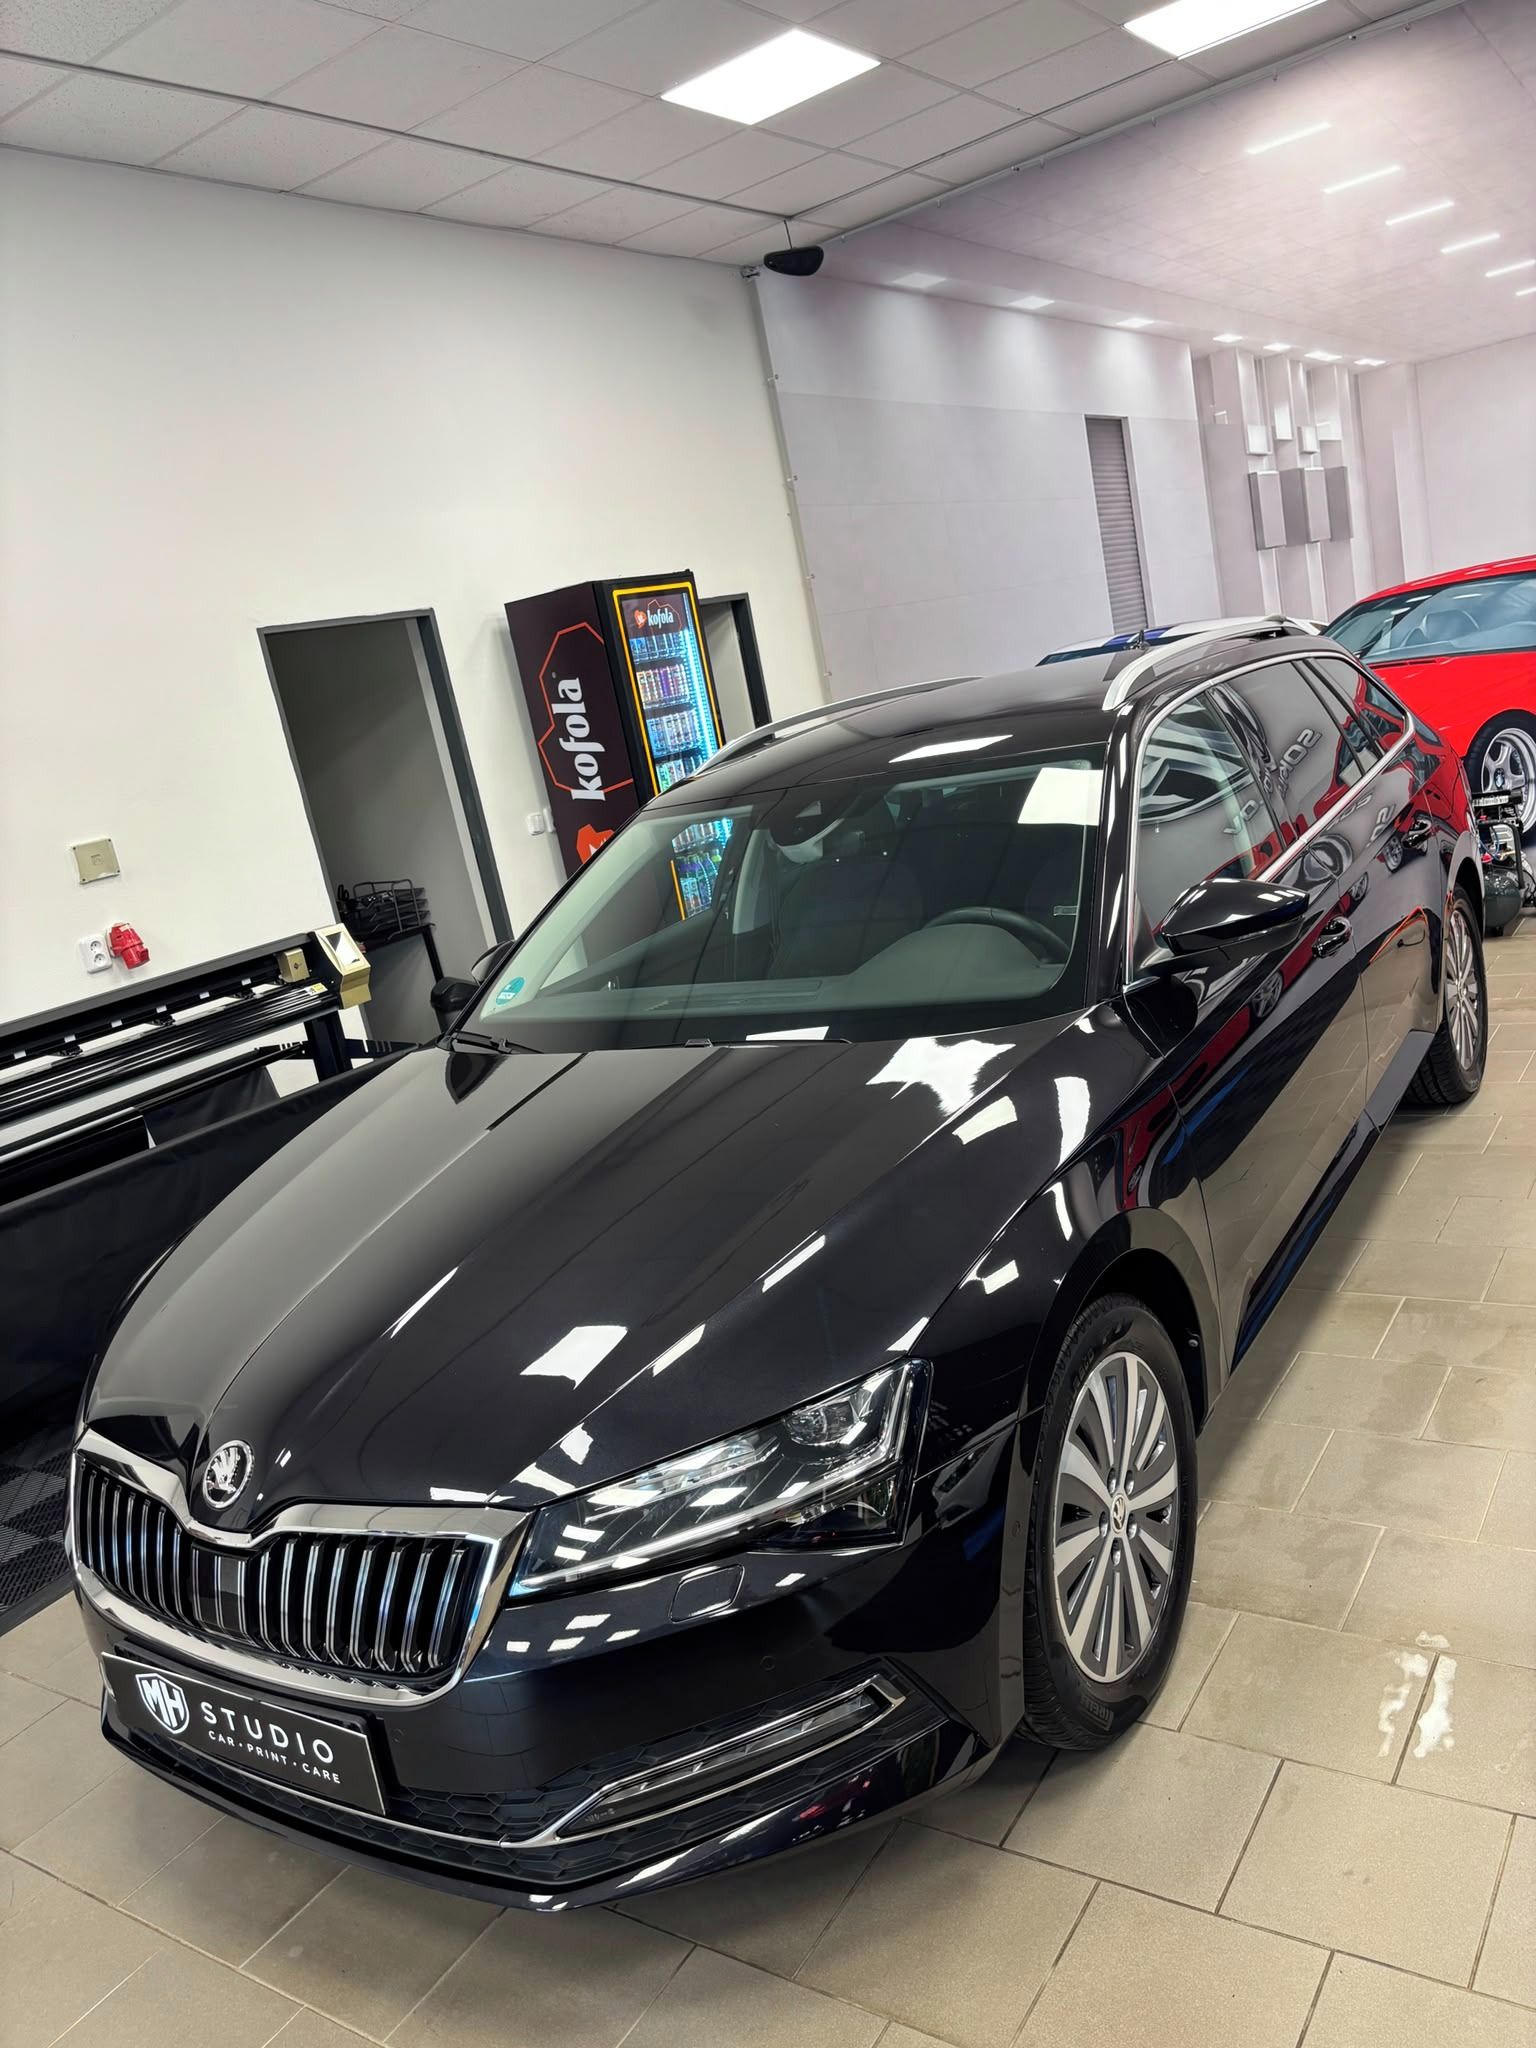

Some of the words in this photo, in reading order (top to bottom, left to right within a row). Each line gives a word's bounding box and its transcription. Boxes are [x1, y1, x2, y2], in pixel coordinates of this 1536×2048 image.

[647, 608, 674, 629] kofola
[551, 676, 606, 802] kofola
[144, 1679, 186, 1728] MH
[200, 1701, 334, 1763] STUDIO
[208, 1730, 236, 1748] CAR
[247, 1744, 288, 1765] PRINT
[302, 1762, 341, 1784] CARE
